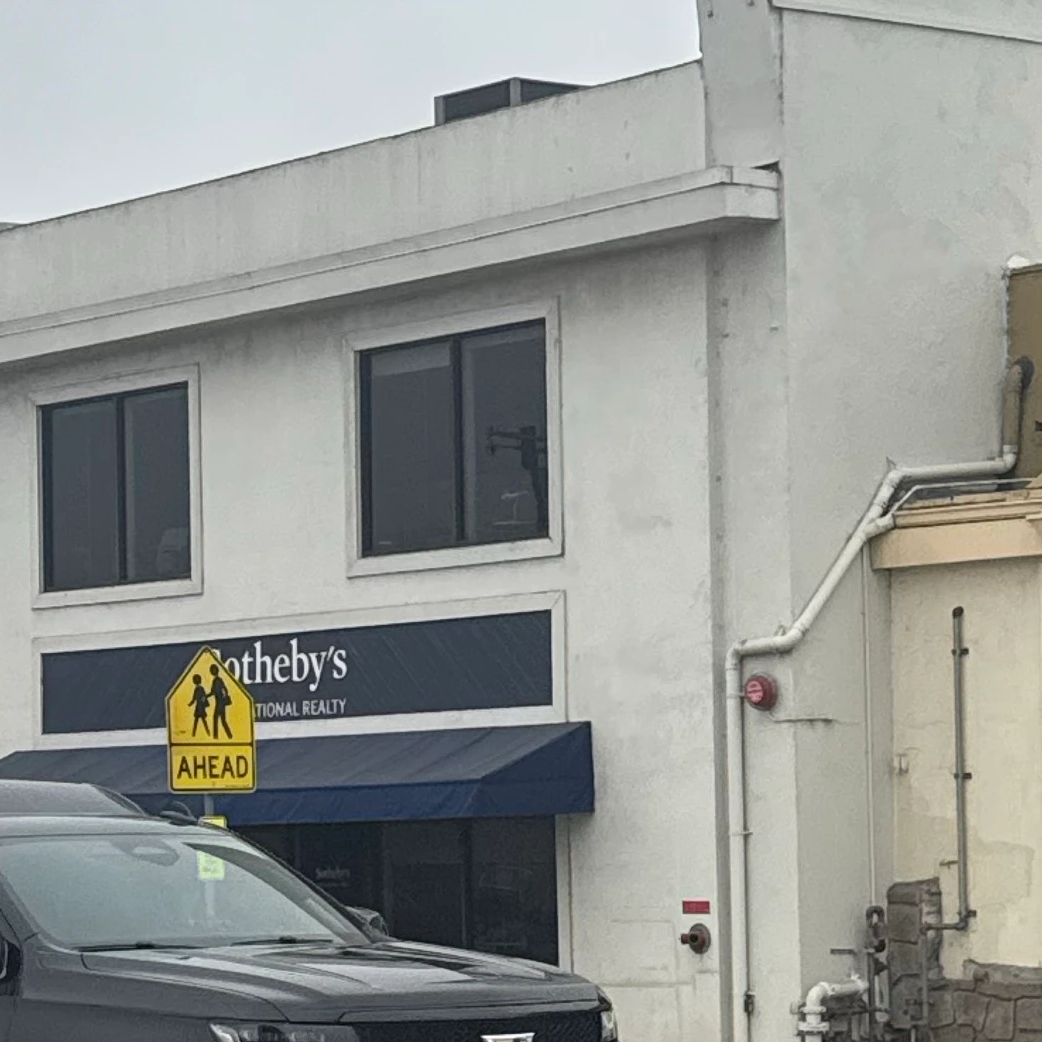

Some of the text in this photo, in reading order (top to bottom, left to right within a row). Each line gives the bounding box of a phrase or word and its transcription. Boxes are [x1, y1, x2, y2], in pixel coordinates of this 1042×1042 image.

[211, 637, 348, 692] otheby's
[255, 698, 347, 719] TIONAL REALTY
[176, 755, 249, 780] AHEAD
